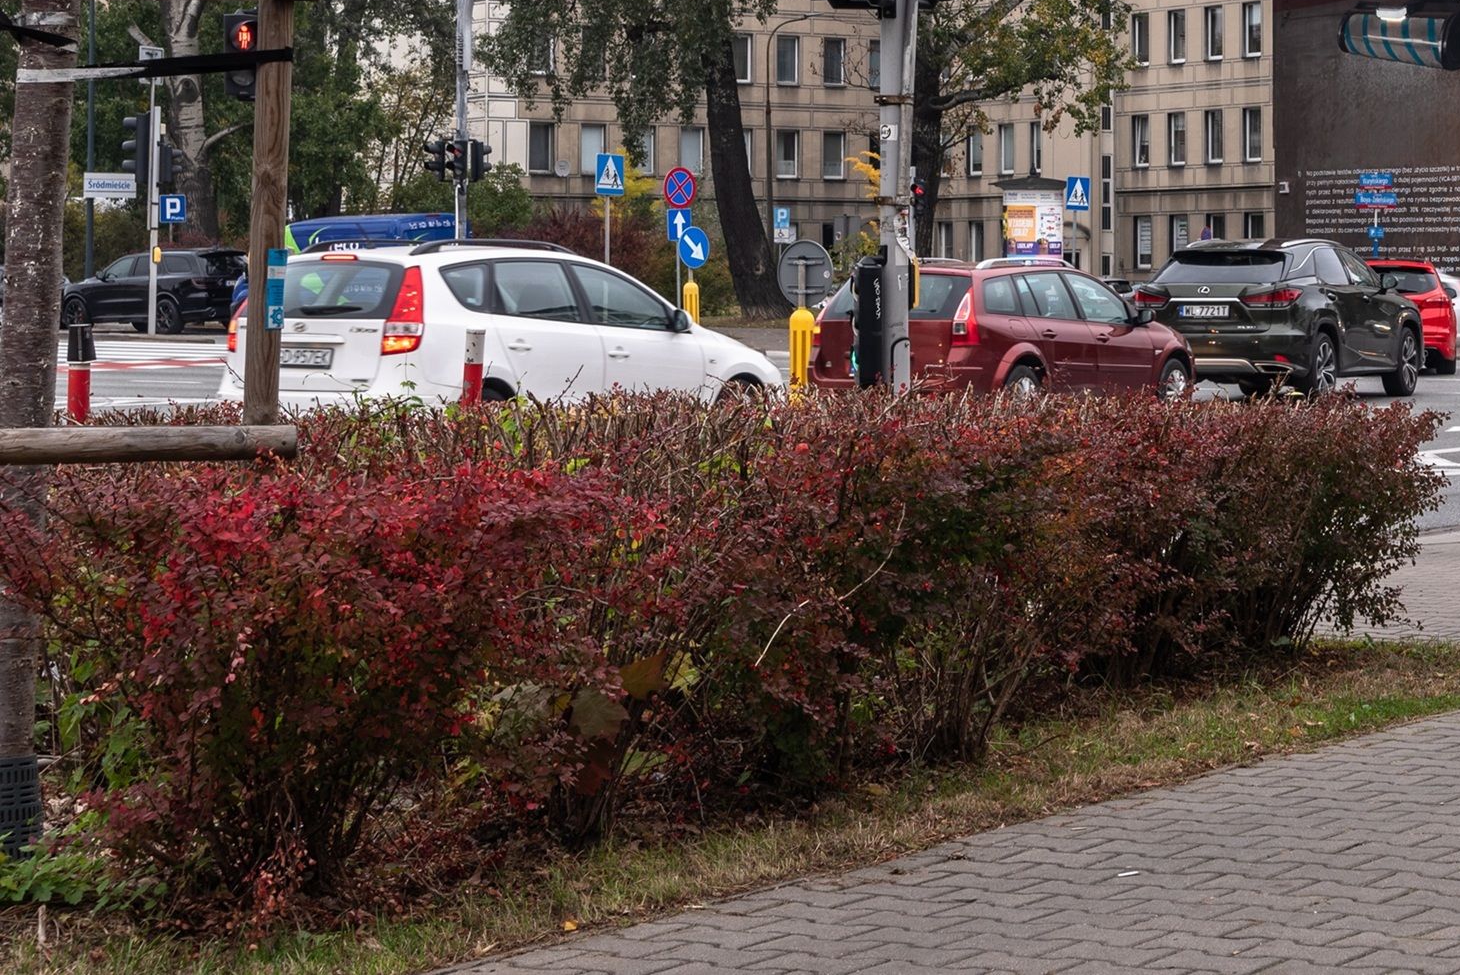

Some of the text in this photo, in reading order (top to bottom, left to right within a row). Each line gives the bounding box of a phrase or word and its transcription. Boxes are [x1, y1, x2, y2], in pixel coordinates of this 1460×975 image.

[88, 180, 130, 190] Śródmieście
[166, 198, 180, 219] P
[778, 208, 787, 222] P
